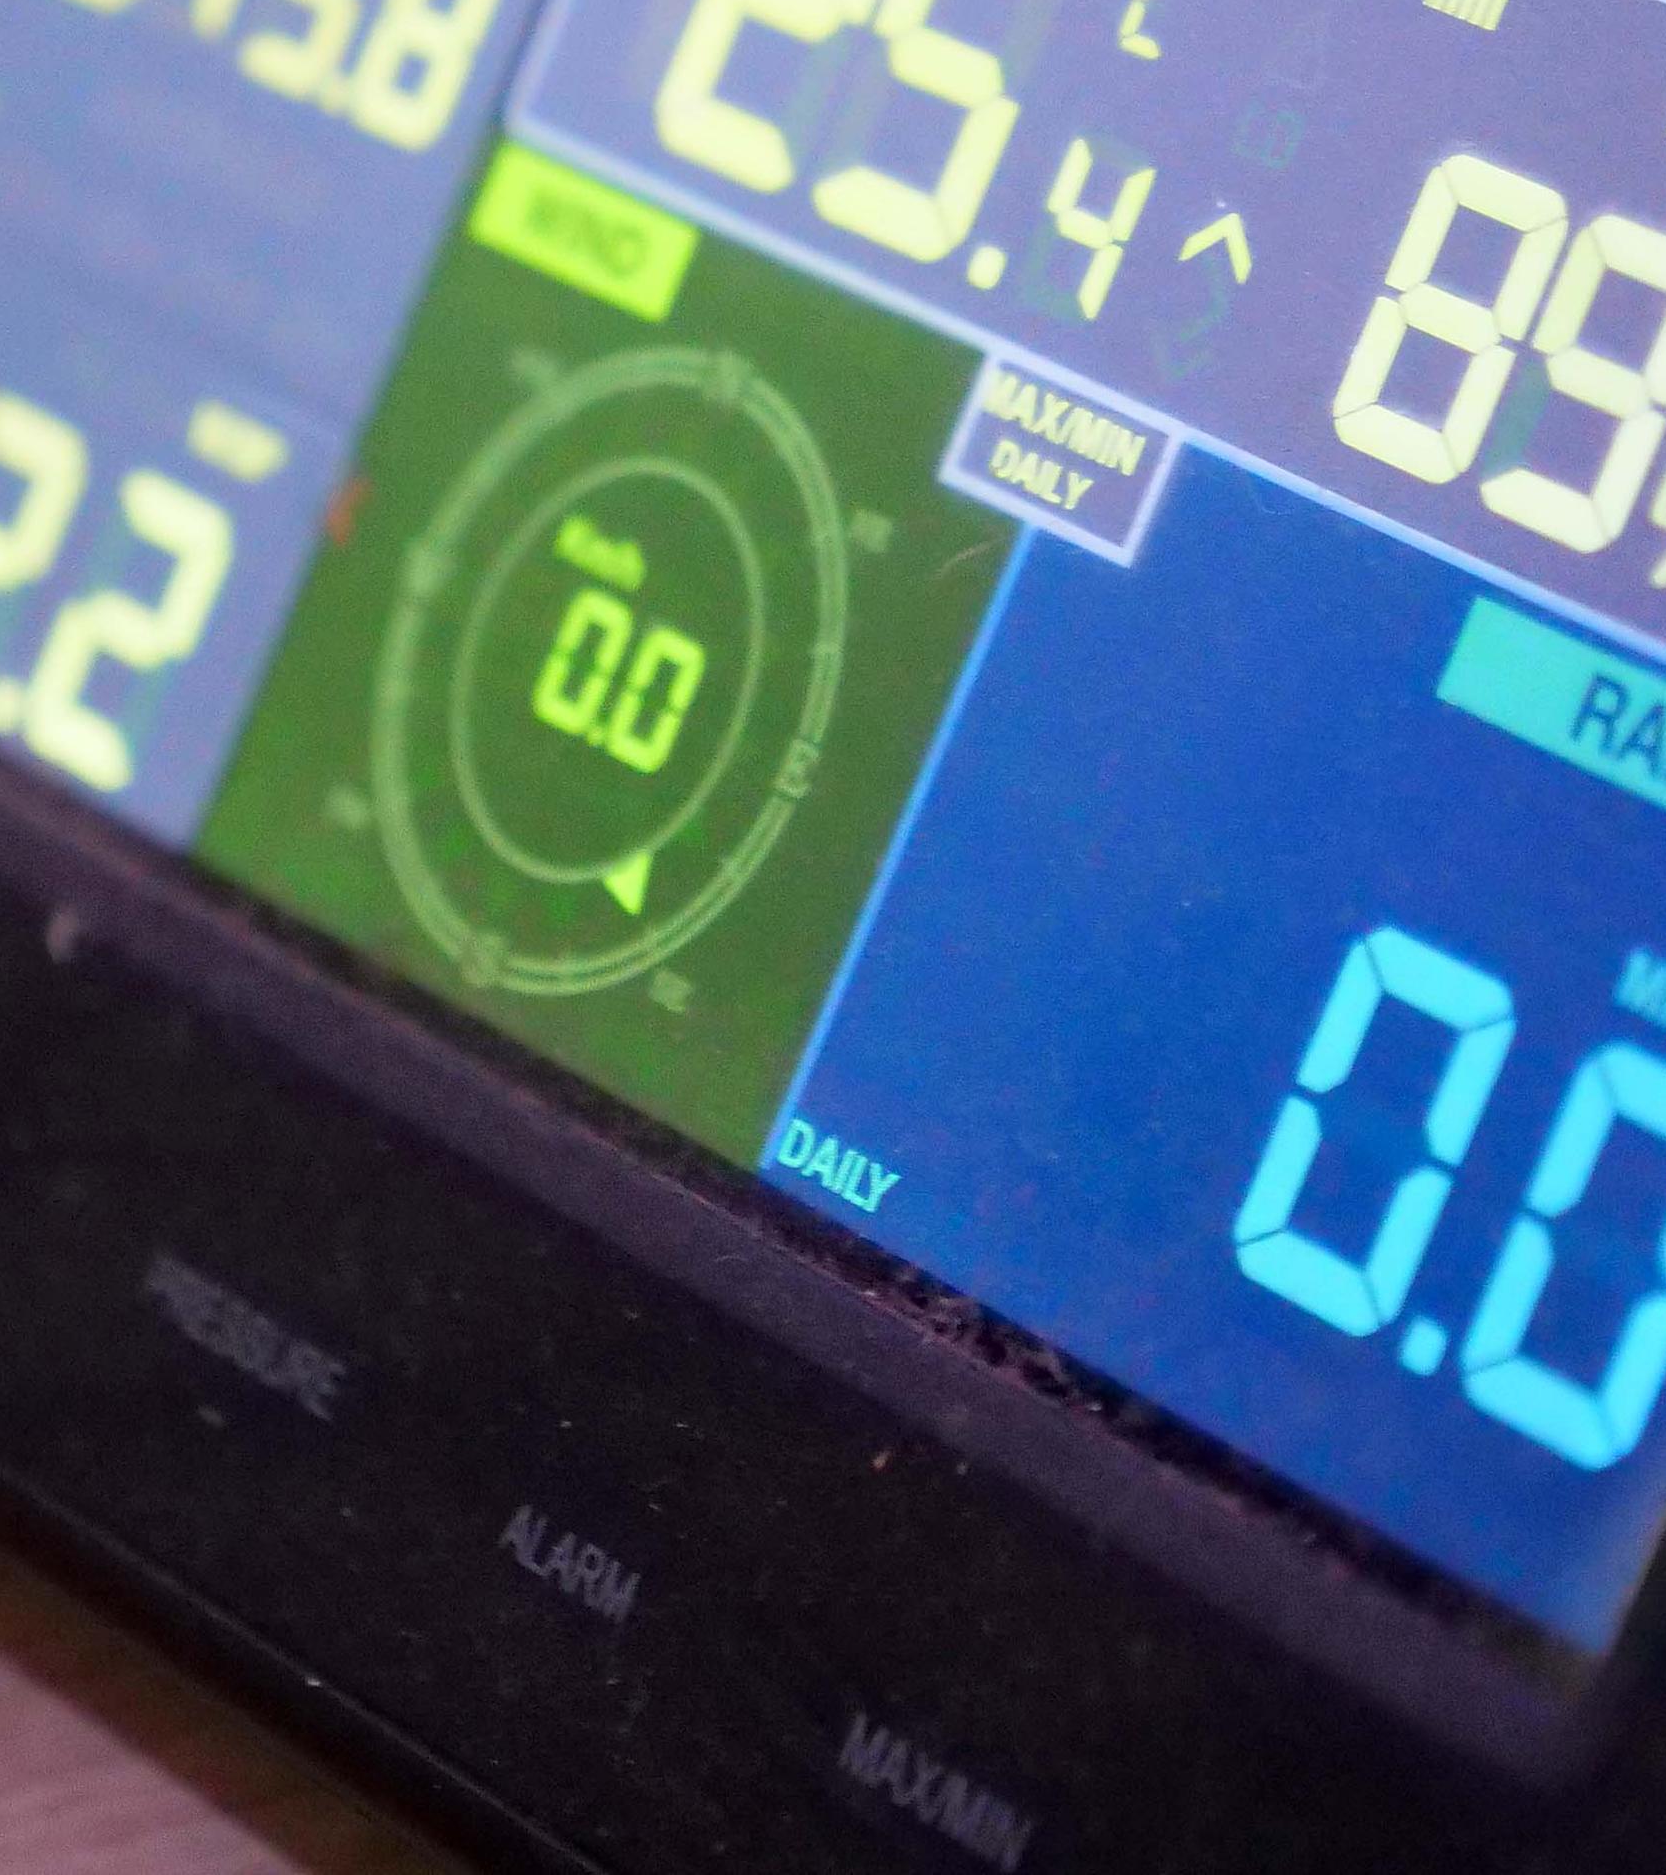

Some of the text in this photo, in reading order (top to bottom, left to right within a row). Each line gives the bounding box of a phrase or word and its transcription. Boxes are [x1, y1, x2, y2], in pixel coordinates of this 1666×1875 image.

[981, 369, 1147, 477] MAX/MIN
[988, 438, 1095, 511] DAILY
[532, 588, 707, 775] 0.0
[776, 1118, 904, 1215] DAILY
[495, 1503, 642, 1625] ALARM
